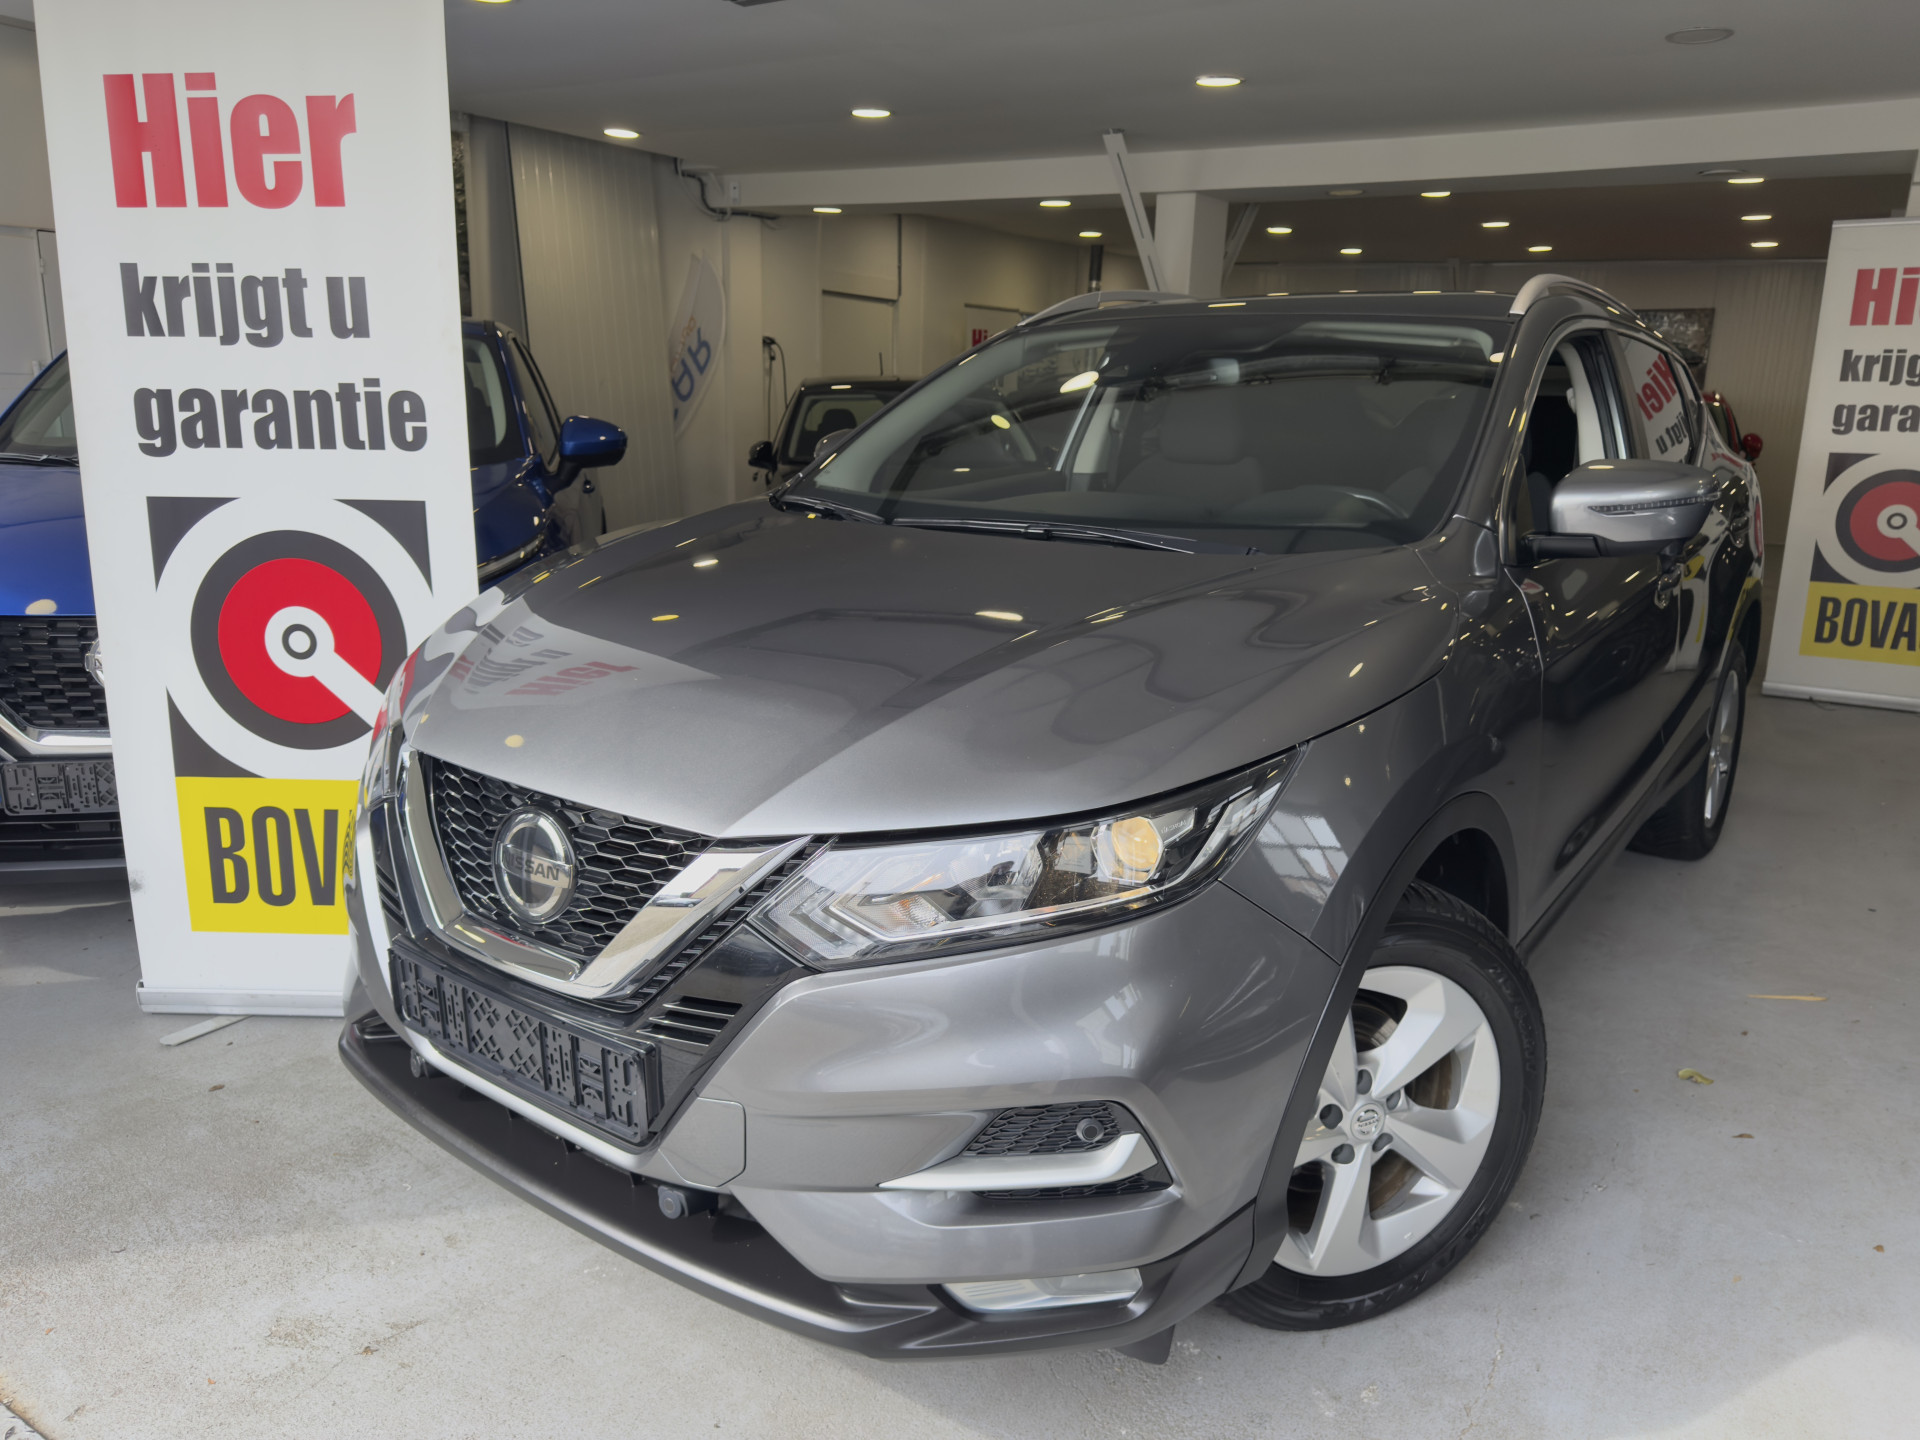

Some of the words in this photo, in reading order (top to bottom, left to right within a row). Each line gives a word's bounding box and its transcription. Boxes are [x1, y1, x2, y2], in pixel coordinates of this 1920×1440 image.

[103, 72, 357, 209] Hier
[119, 262, 313, 348] krijgt
[326, 276, 371, 339] u
[1839, 348, 1920, 387] krijg
[133, 378, 428, 457] garantie
[1832, 402, 1920, 435] gara
[1814, 596, 1919, 652] BOVA
[204, 806, 338, 906] BOV
[504, 848, 561, 881] NISSAN
